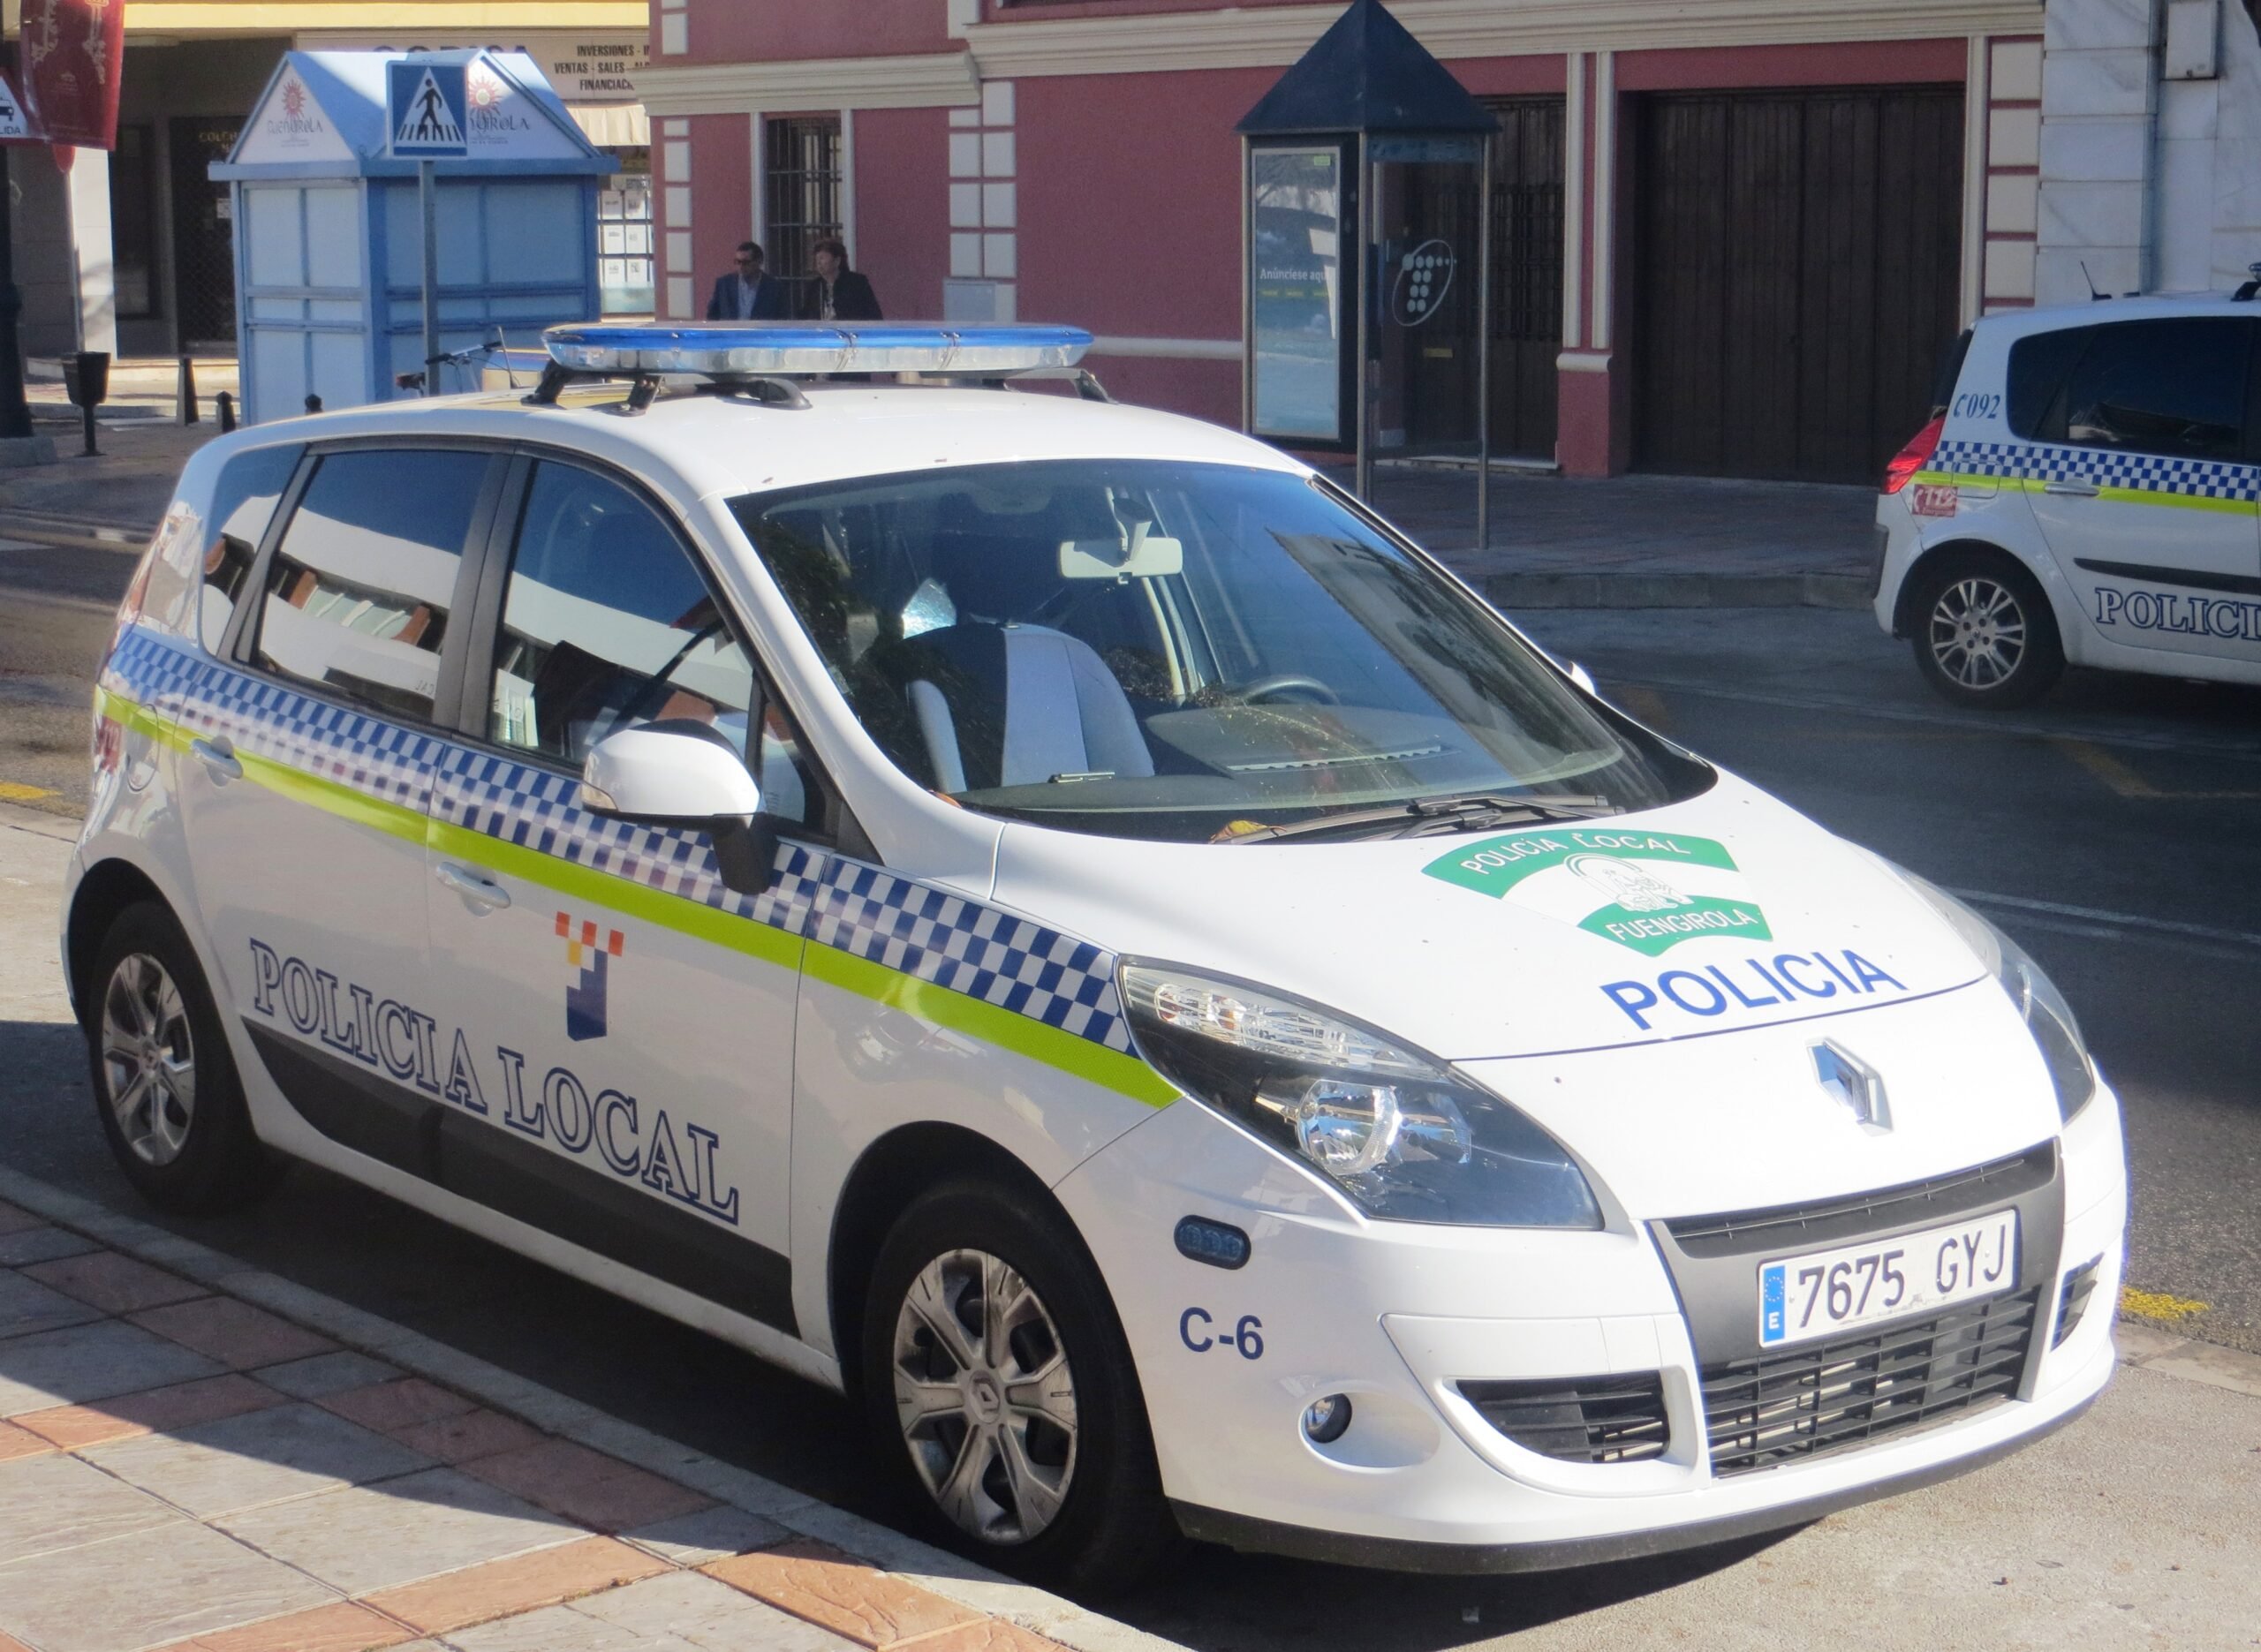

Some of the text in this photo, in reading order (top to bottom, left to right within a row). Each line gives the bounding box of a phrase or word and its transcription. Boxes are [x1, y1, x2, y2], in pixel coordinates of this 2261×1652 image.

[577, 44, 635, 57] INVERSIONES
[554, 62, 589, 74] VENTAS
[597, 62, 625, 73] SALES
[1259, 267, 1308, 280] Anúnciese
[1966, 393, 2001, 419] 092
[1571, 834, 1691, 855] LOCAL
[1604, 908, 1759, 941] FUENGIROLA
[1599, 949, 1909, 1030] POLICIA
[249, 938, 738, 1226] POLICIA LOCAL
[1798, 1225, 2007, 1328] 7675 GYJ
[1179, 1306, 1264, 1361] C-6
[1768, 1311, 1781, 1331] E
